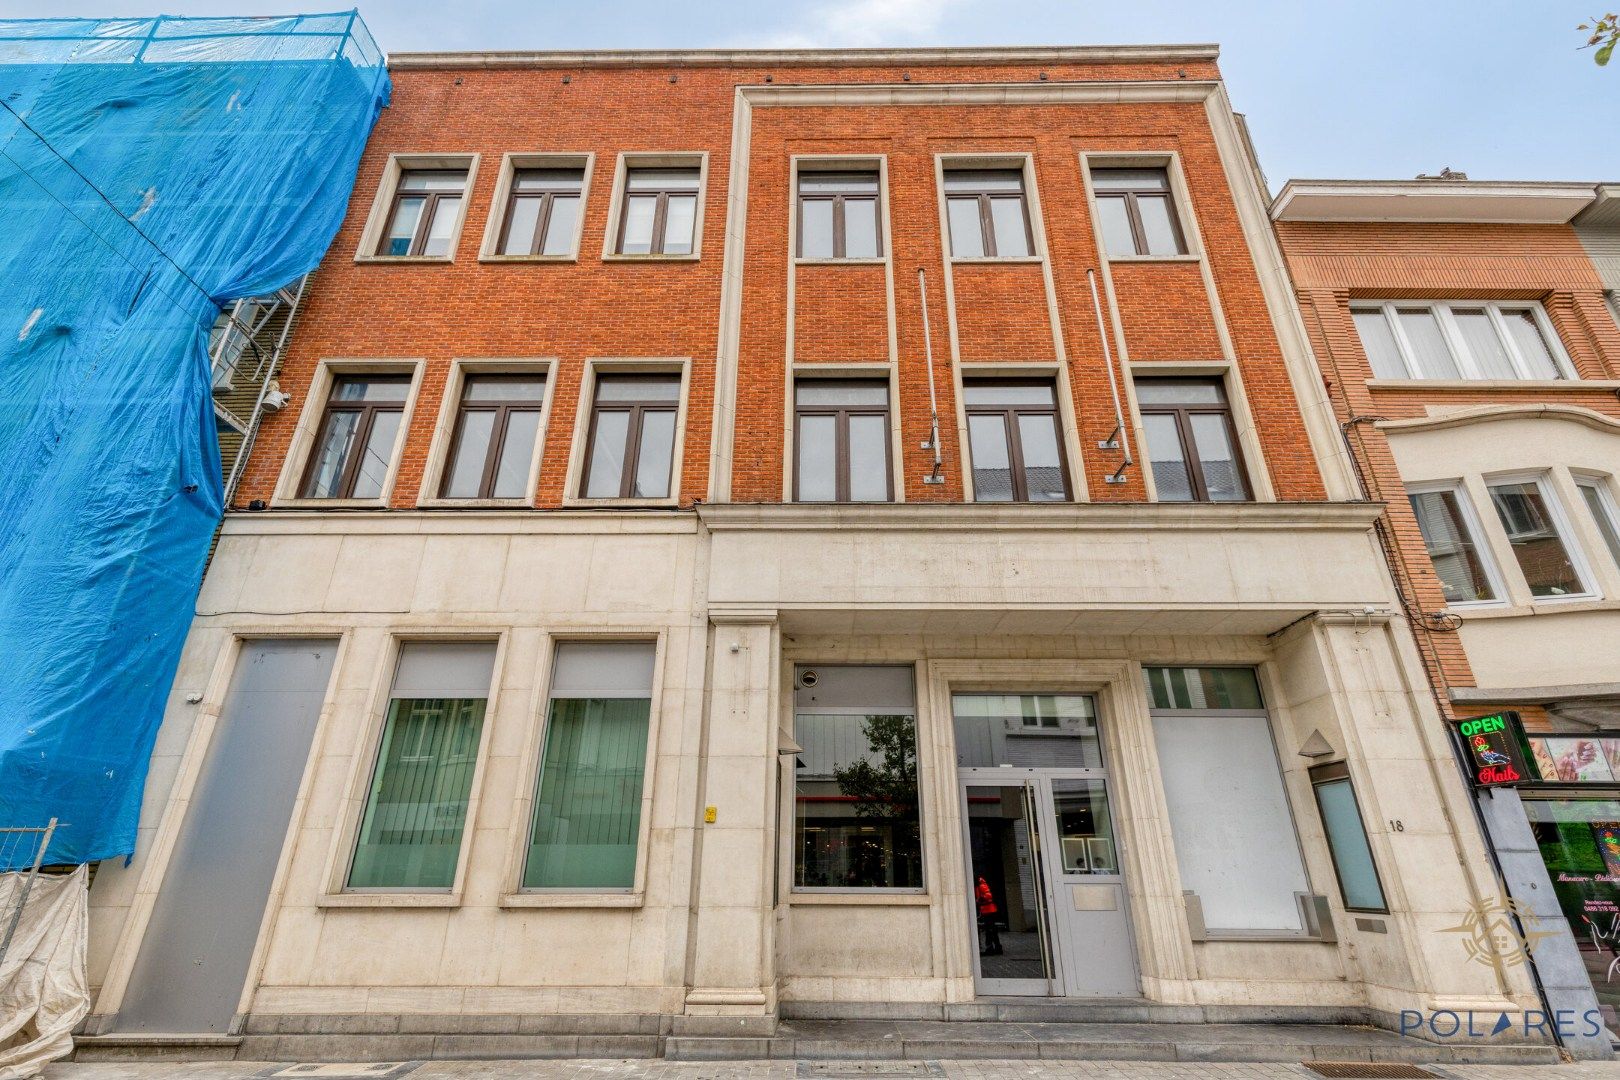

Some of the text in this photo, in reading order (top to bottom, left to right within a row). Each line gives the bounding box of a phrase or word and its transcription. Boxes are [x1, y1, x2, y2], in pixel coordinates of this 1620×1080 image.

[1461, 716, 1505, 736] OPEN
[1479, 765, 1520, 784] Nails
[1390, 820, 1403, 832] 18
